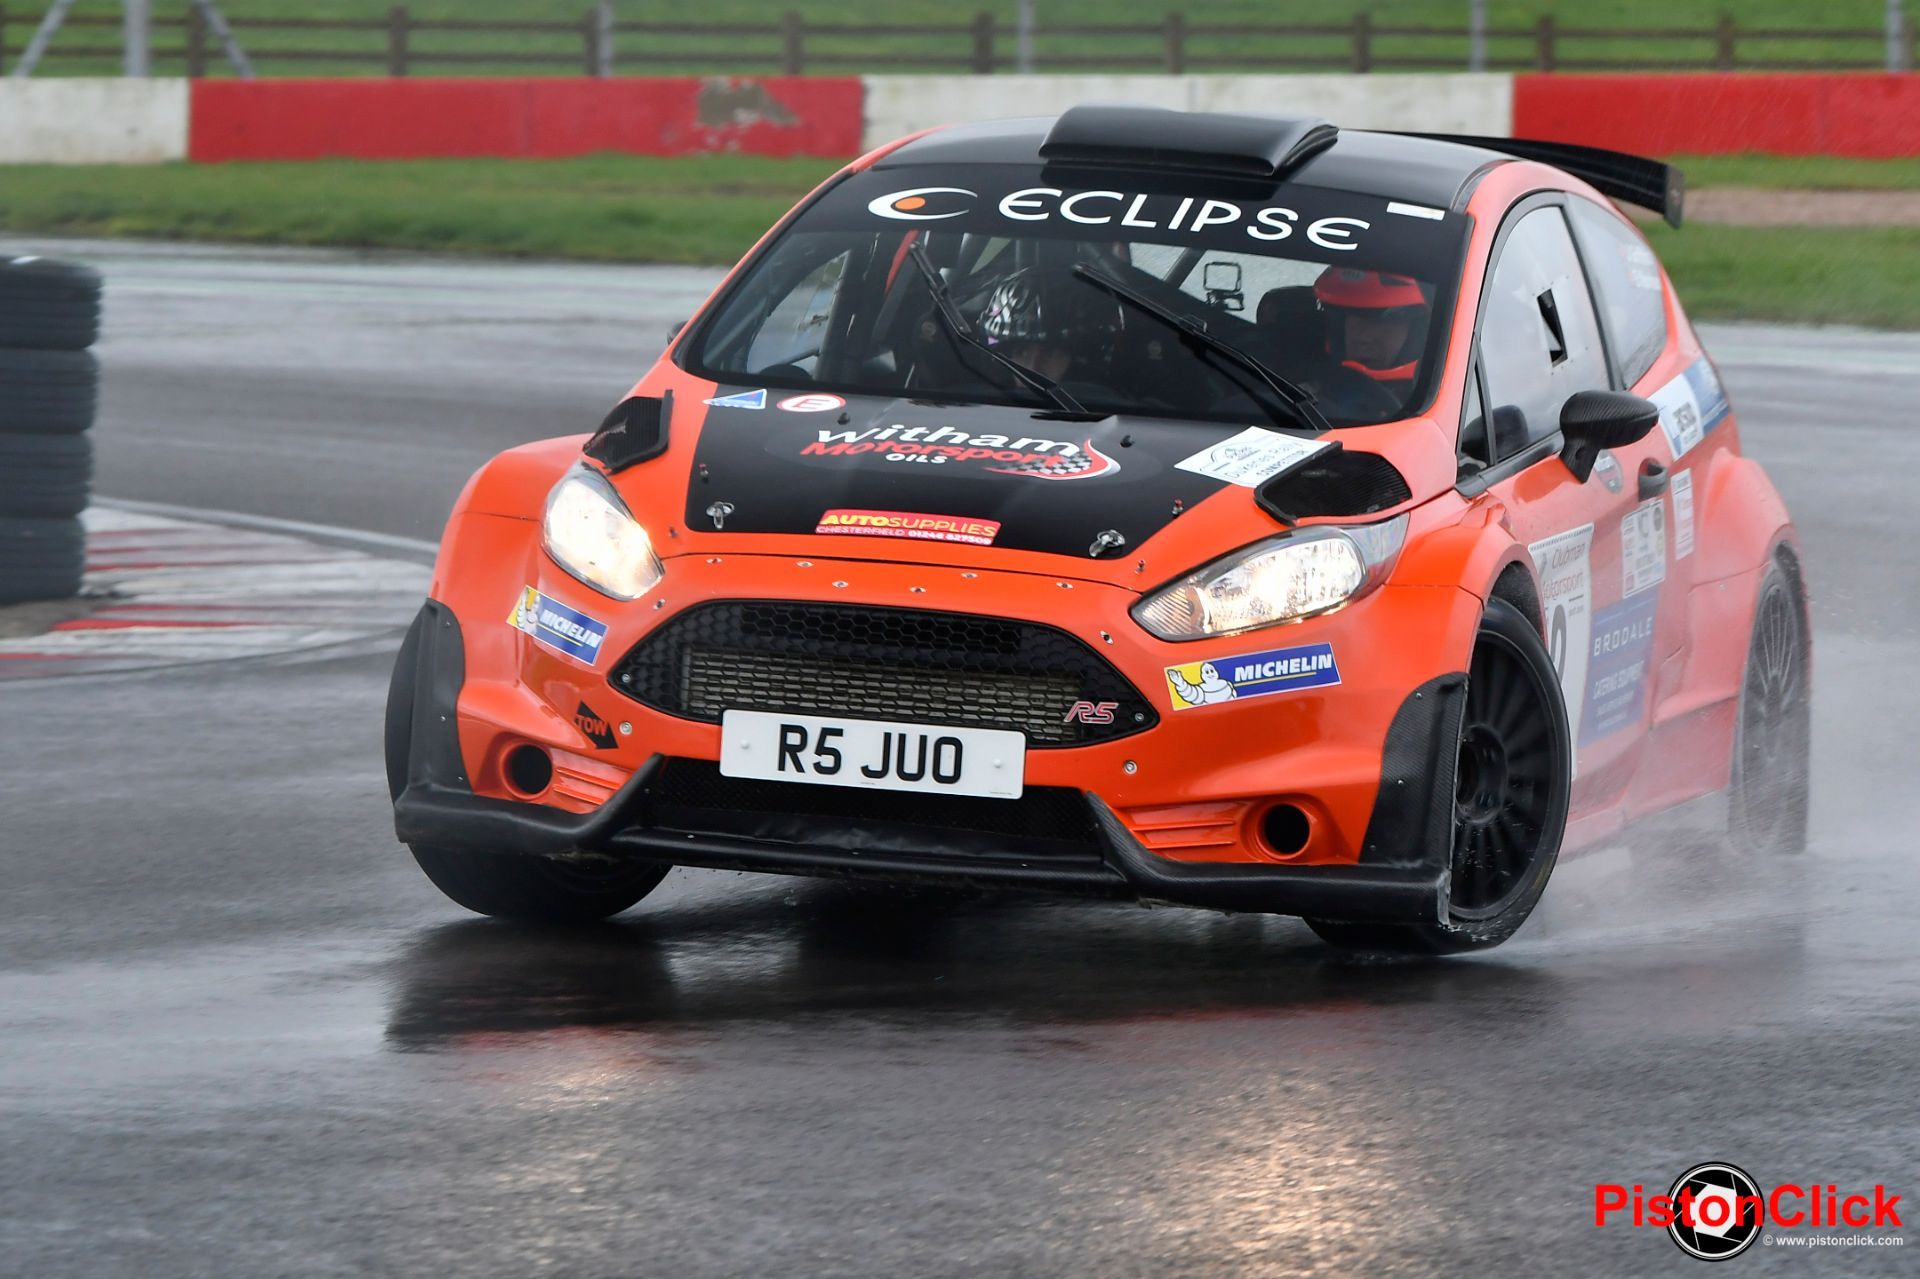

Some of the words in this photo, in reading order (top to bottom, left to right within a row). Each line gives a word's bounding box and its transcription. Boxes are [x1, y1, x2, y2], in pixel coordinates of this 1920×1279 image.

[999, 188, 1371, 250] ECLIPSE
[792, 398, 830, 410] E
[801, 440, 1066, 465] Motorsport
[818, 424, 1080, 456] witham
[885, 453, 948, 464] OILS
[816, 526, 905, 536] CHESTERFIELD
[820, 514, 996, 537] AUTOSUPPLIES
[539, 609, 602, 648] MICHELIN
[1593, 616, 1653, 656] BRODALE
[1234, 653, 1332, 682] MICHELIN
[575, 714, 608, 737] TOW
[777, 723, 844, 775] R5
[860, 731, 963, 785] JUO
